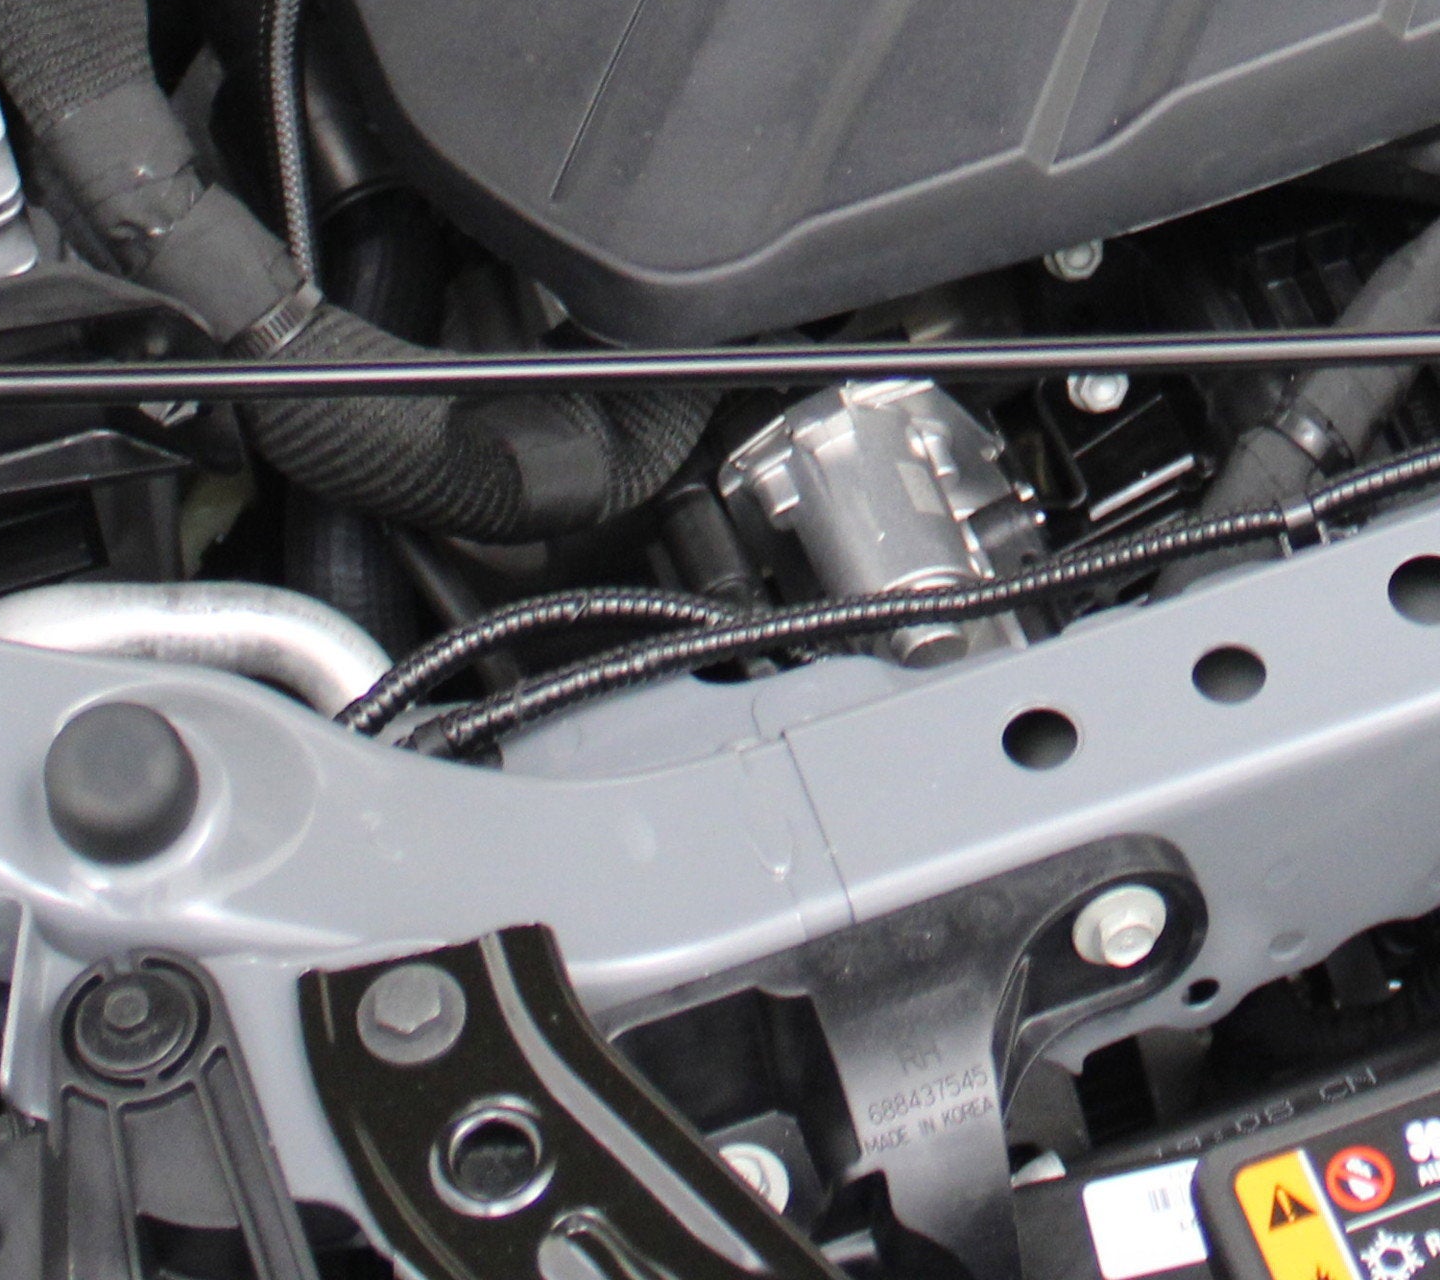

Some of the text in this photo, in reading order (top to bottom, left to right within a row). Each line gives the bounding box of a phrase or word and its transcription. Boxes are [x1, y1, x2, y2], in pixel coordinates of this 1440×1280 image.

[899, 1044, 942, 1074] RH
[862, 1097, 995, 1155] MADE IN KOREA
